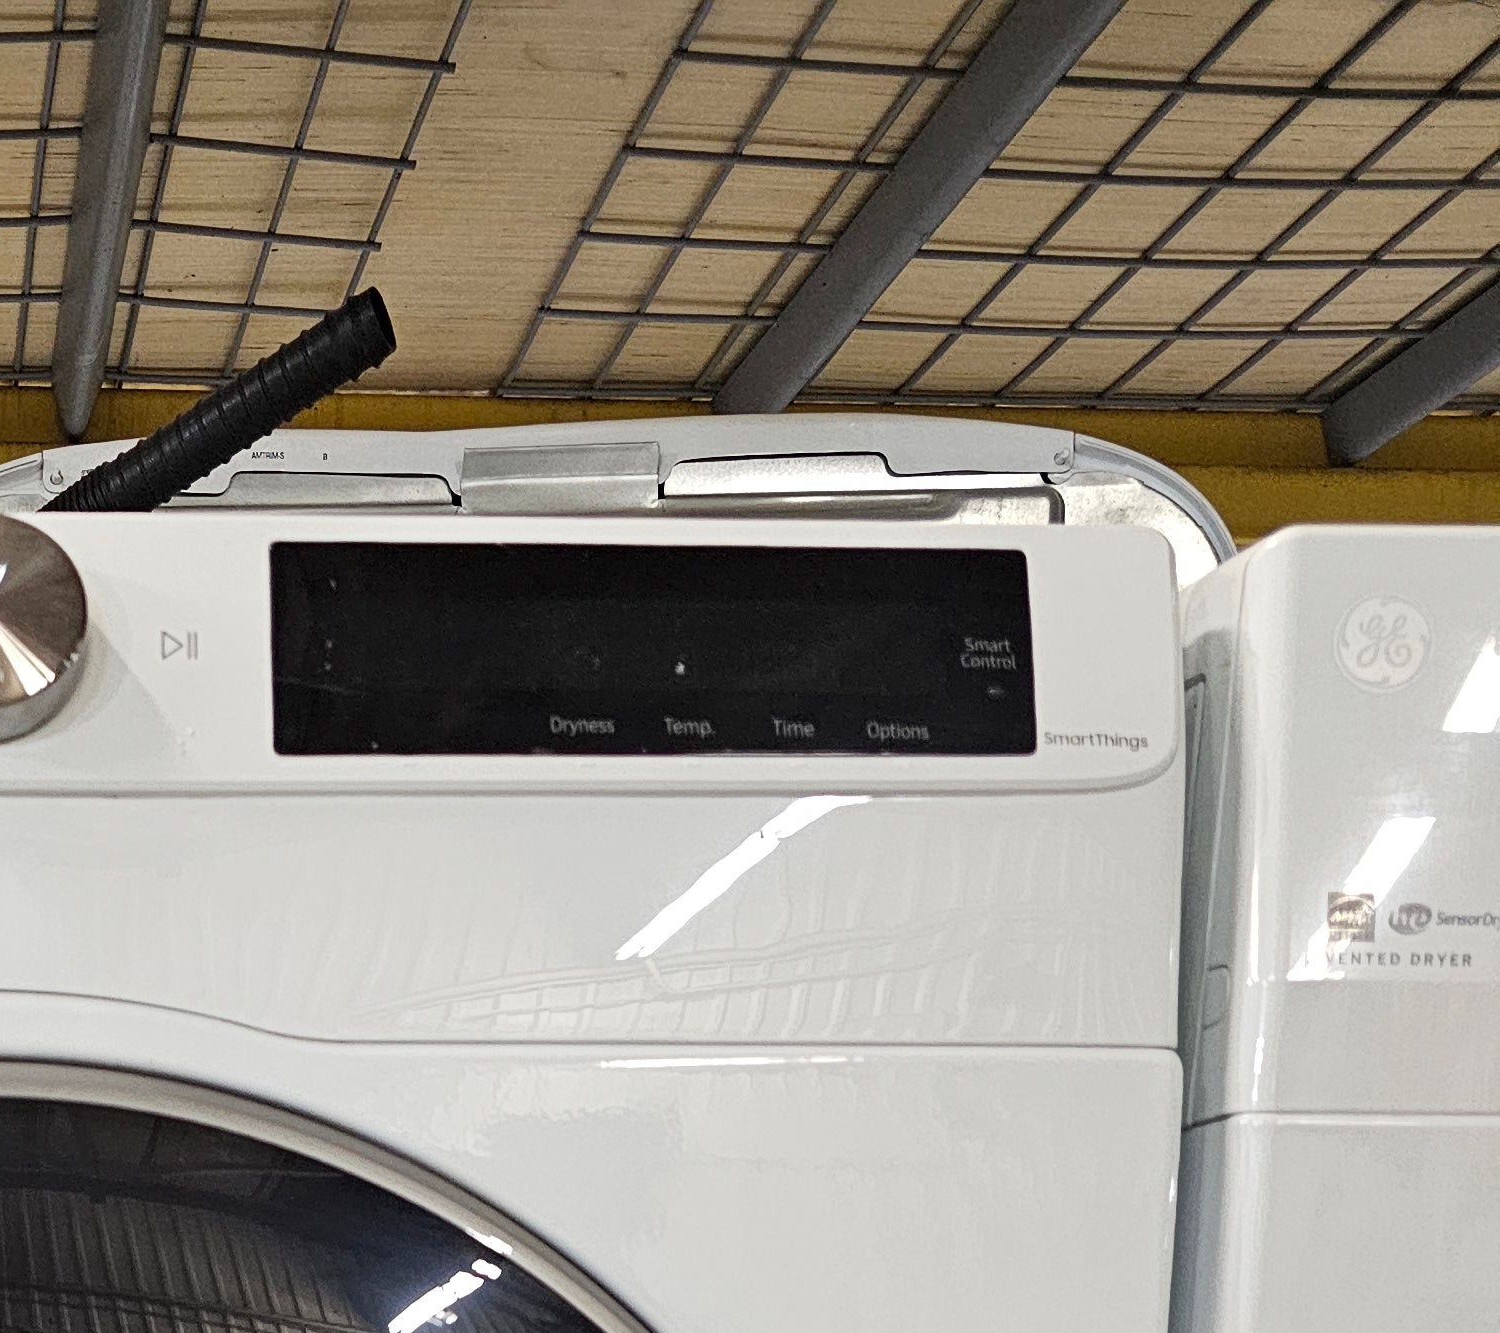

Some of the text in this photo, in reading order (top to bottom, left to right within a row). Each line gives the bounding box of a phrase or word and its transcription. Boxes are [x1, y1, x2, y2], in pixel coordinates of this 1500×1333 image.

[964, 637, 1011, 652] Smart
[960, 653, 1017, 670] Control
[550, 715, 615, 737] Dryness
[664, 716, 716, 739] Temp.
[773, 717, 816, 738] Time
[866, 719, 930, 741] Options
[1044, 731, 1149, 752] SmartThings
[1410, 952, 1472, 969] DRYER
